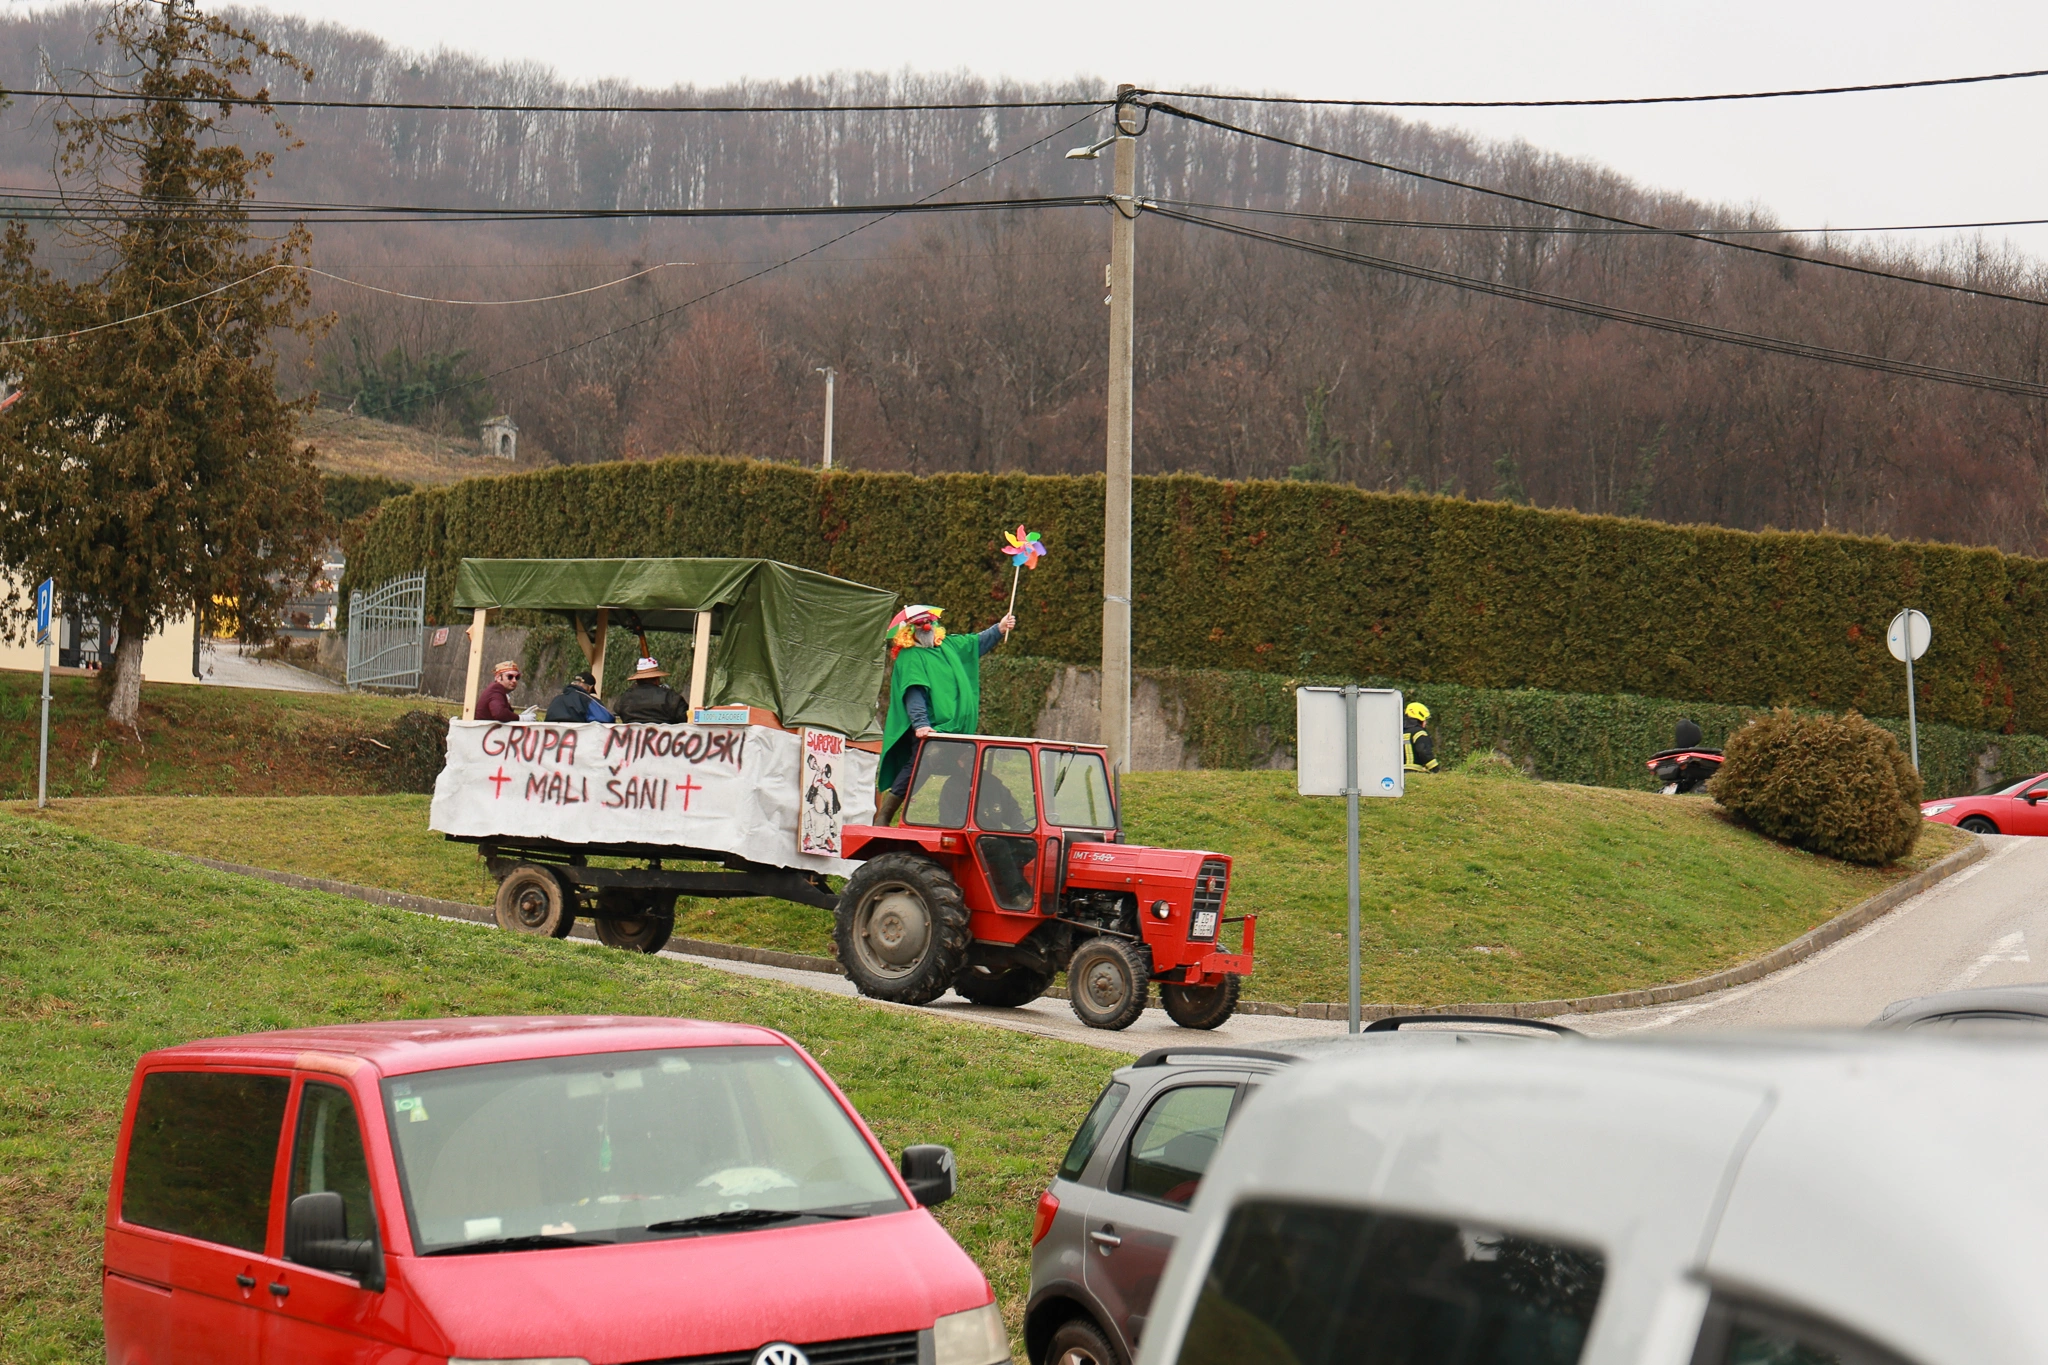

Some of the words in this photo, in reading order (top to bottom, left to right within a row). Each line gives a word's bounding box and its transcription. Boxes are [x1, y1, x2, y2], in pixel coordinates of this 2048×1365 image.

[41, 589, 48, 627] P
[482, 724, 578, 765] GRUPA
[603, 726, 746, 771] MIROGOJSKI
[525, 772, 589, 805] MALI
[602, 761, 668, 811] ŠANI
